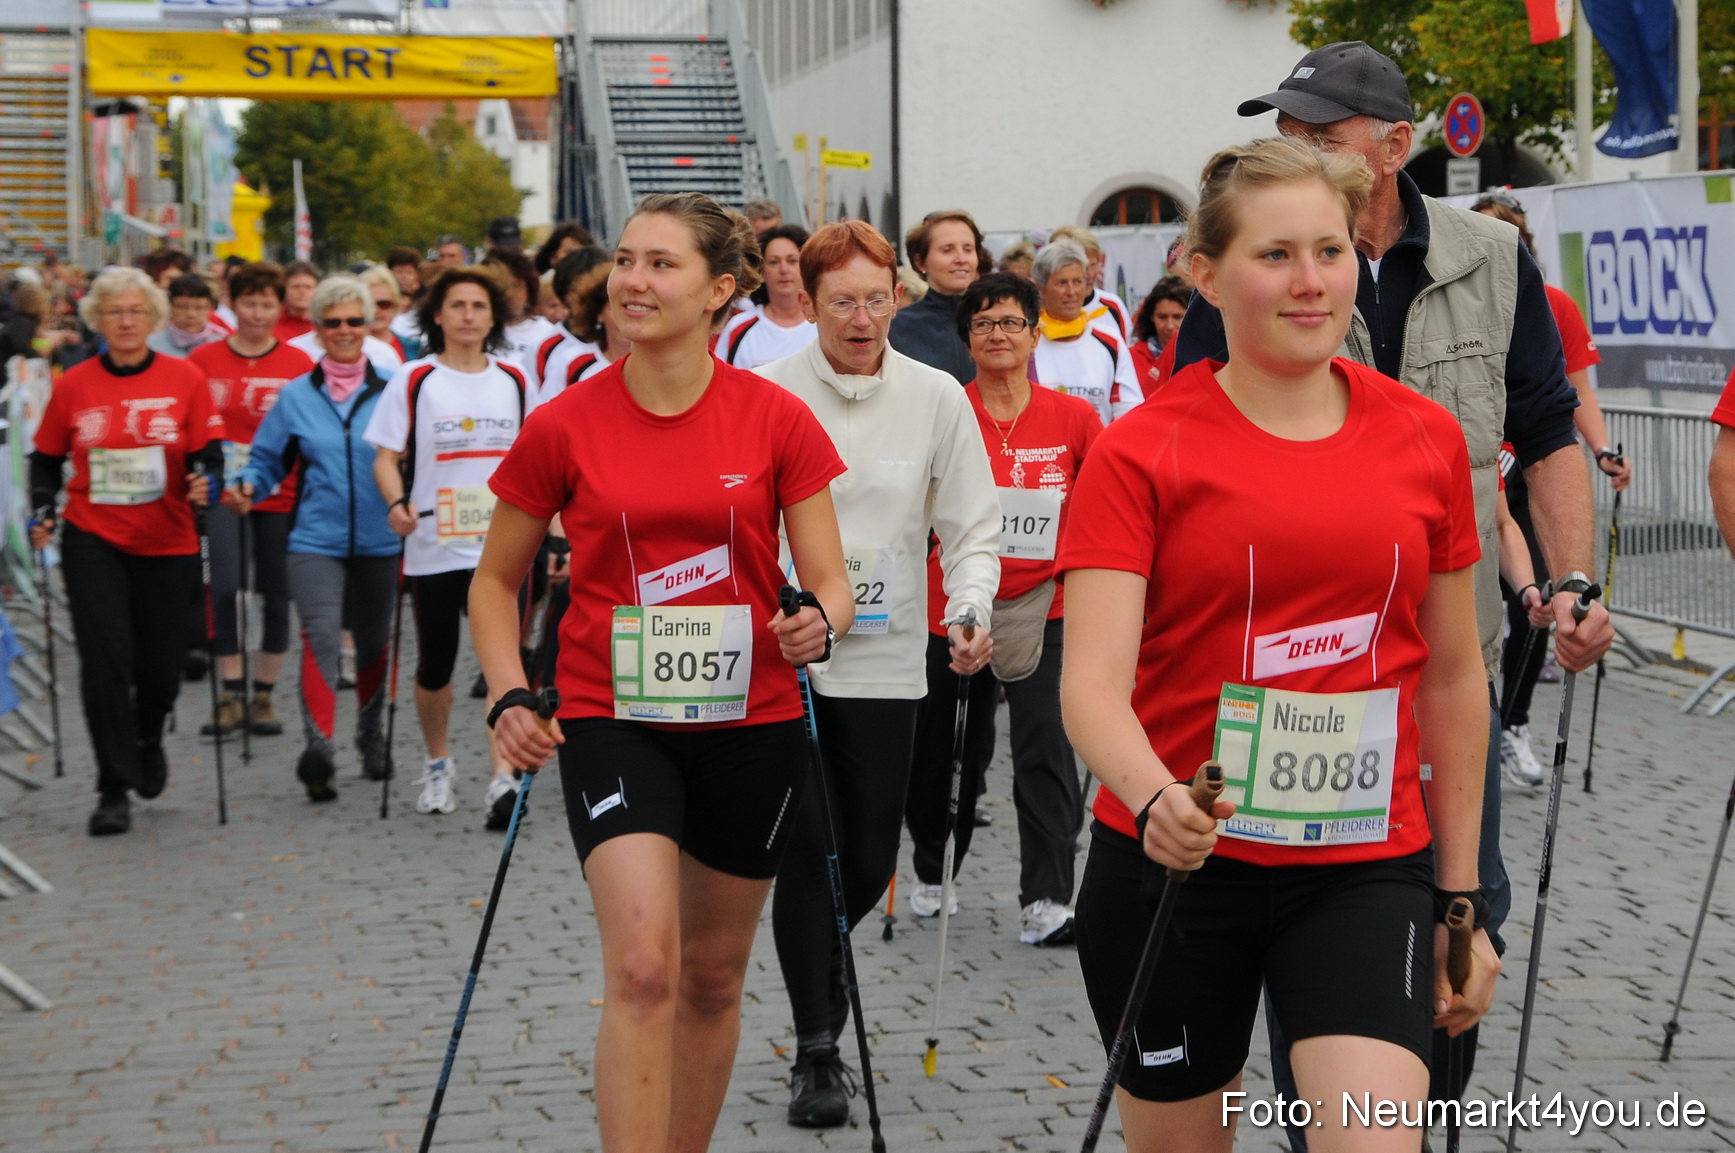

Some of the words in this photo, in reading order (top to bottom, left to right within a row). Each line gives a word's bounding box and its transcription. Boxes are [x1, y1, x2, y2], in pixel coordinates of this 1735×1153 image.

[245, 46, 402, 79] START
[1587, 225, 1717, 336] BOCK
[1014, 454, 1058, 463] STADTLAUF
[1015, 445, 1067, 456] NEUMARKTER
[665, 564, 705, 590] DEHN
[652, 615, 711, 636] Carina
[1287, 632, 1344, 659] DEHN
[654, 651, 741, 682] 8057
[700, 702, 745, 713] PFLEIDERER
[1273, 702, 1345, 733] Nicole
[1269, 750, 1381, 792] 8088
[1324, 818, 1385, 833] PFLEIDERER
